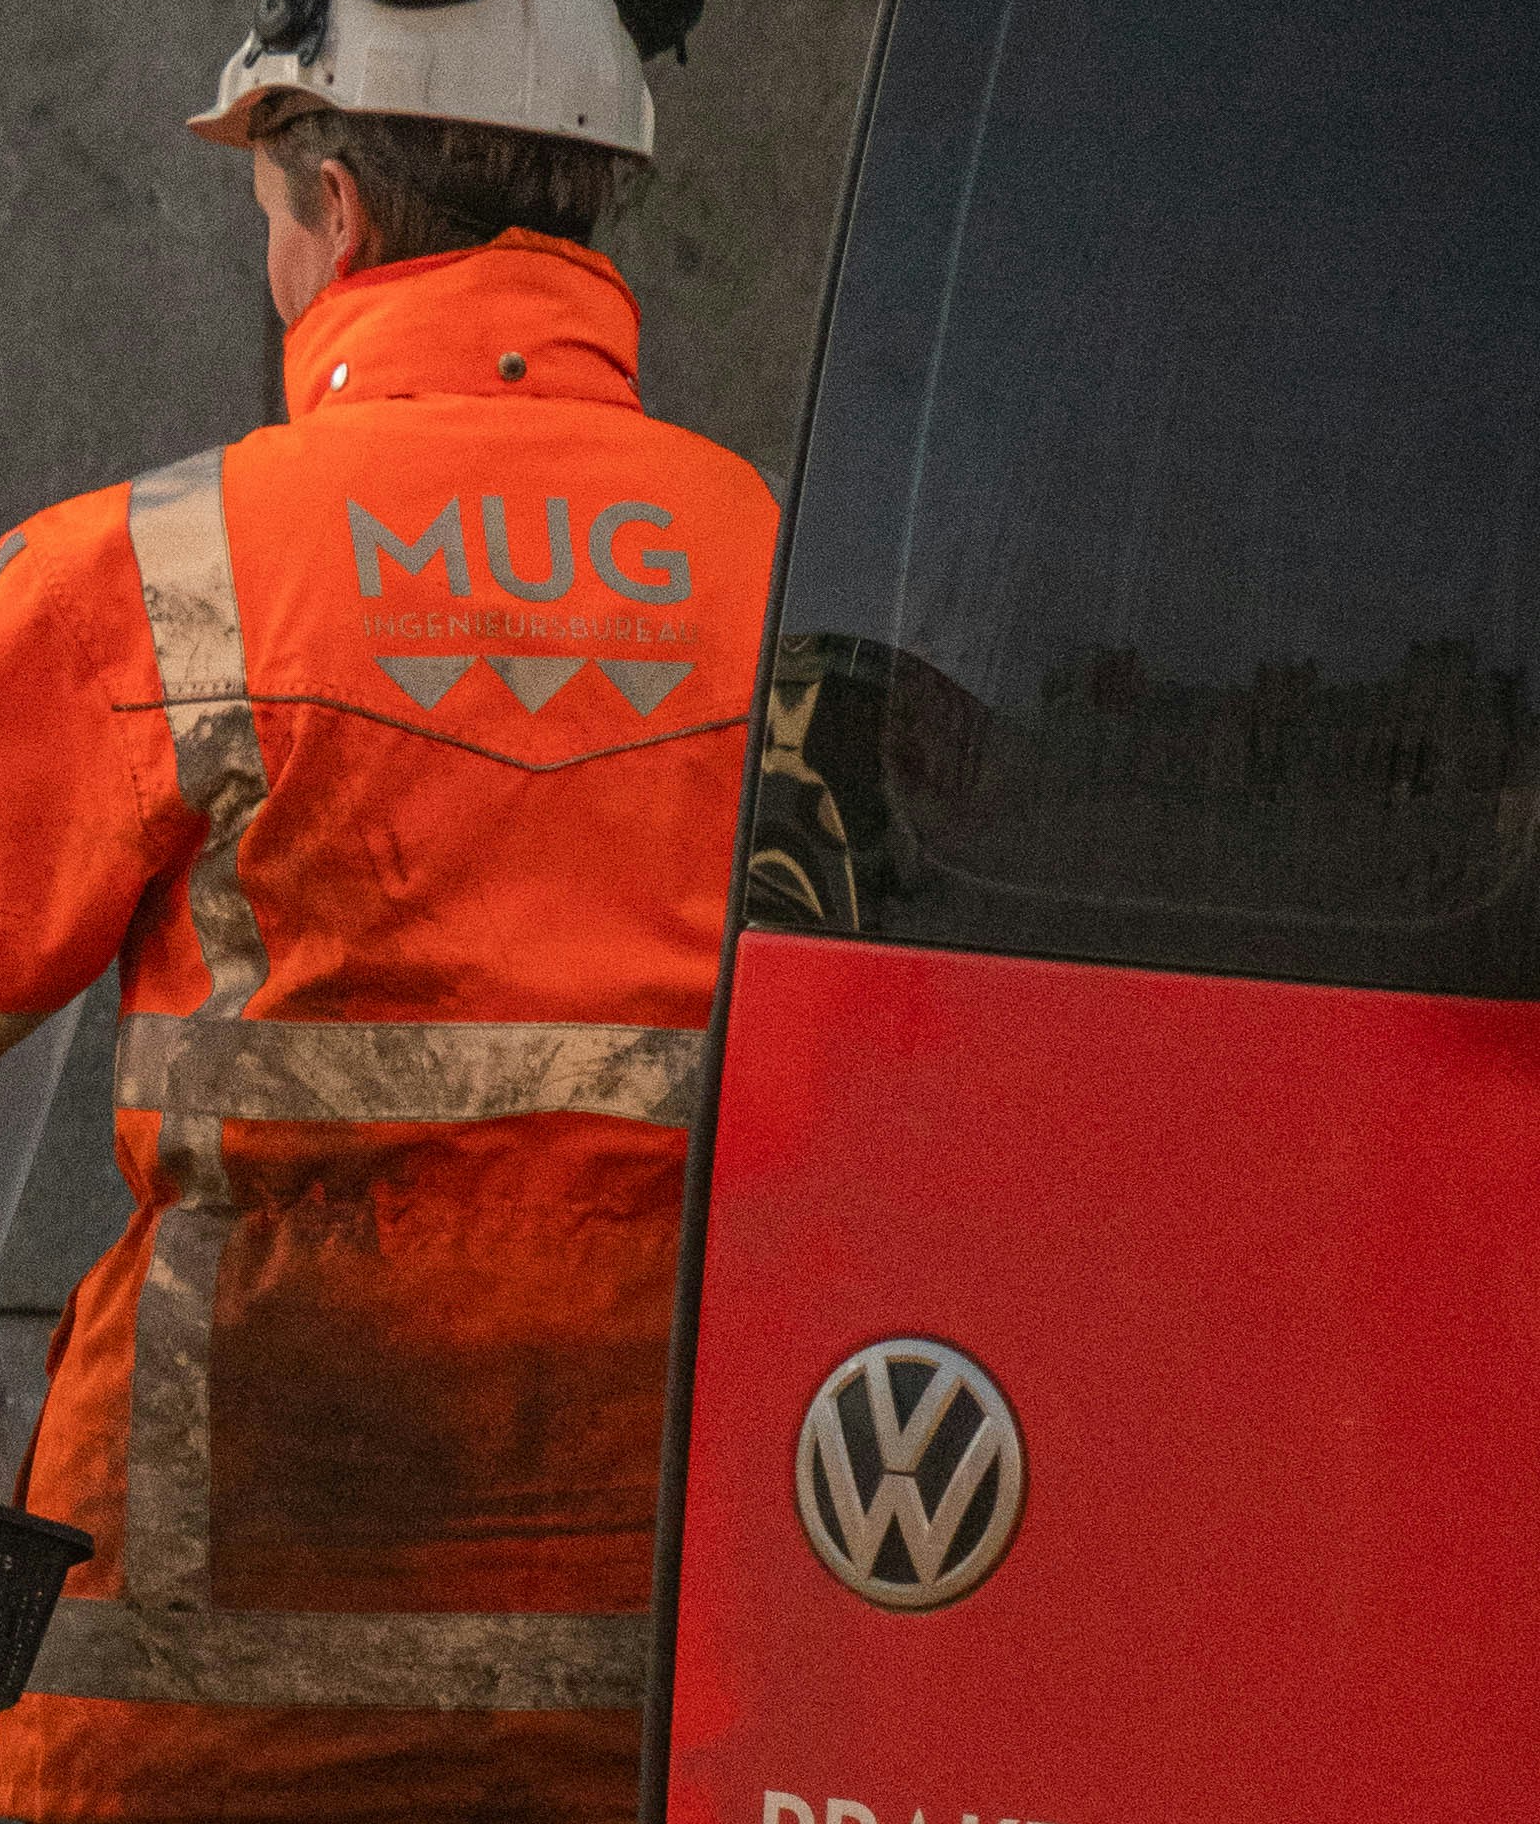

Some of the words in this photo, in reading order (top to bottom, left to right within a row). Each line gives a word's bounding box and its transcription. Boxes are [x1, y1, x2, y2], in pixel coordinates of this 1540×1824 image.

[346, 494, 693, 604] MUG
[363, 610, 699, 645] INGENIEURSBUREAU
[798, 1340, 1021, 1608] VW
